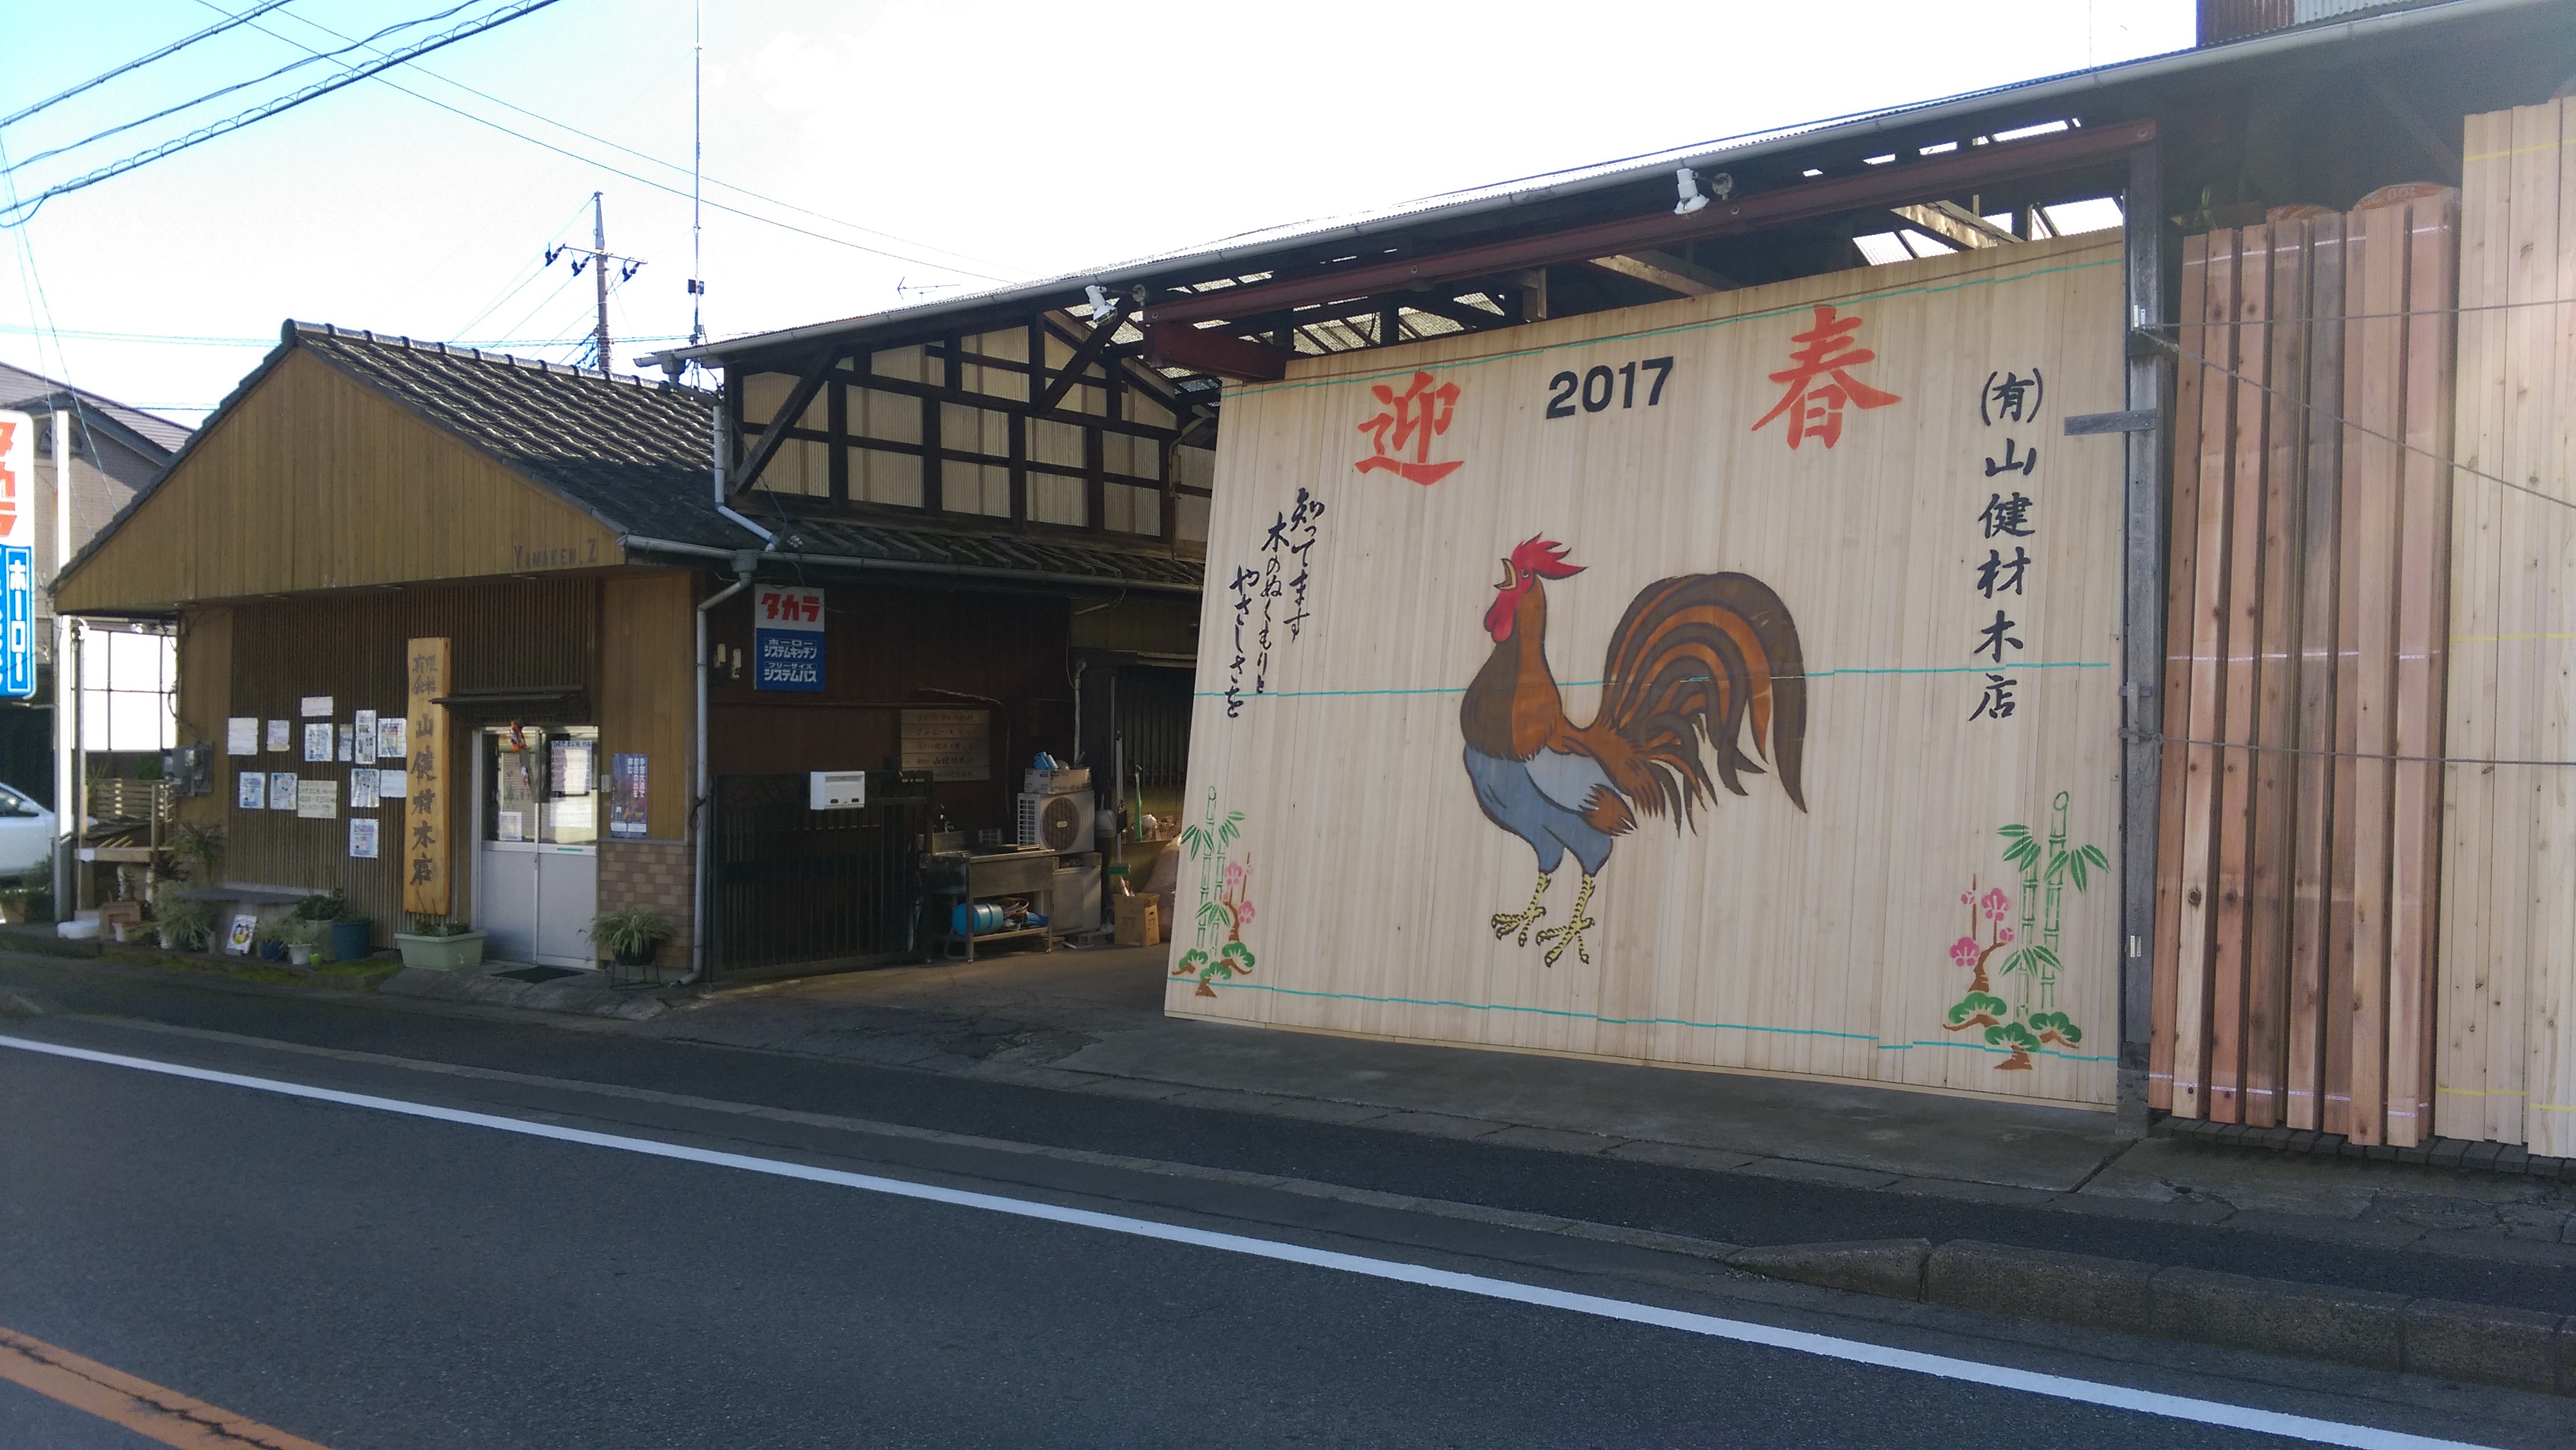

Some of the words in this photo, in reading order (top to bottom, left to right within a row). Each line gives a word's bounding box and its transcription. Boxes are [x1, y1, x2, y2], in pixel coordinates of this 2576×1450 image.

[1355, 370, 1465, 486] 迎
[1546, 356, 1674, 419] 2017
[1751, 304, 1902, 450] 春
[9, 559, 26, 683] ホーロー
[761, 592, 821, 623] タカラ
[1283, 487, 1325, 644] 知ってます
[764, 645, 817, 659] システムキッチン
[764, 669, 817, 683] システムバス
[1224, 565, 1260, 718] やさしさを
